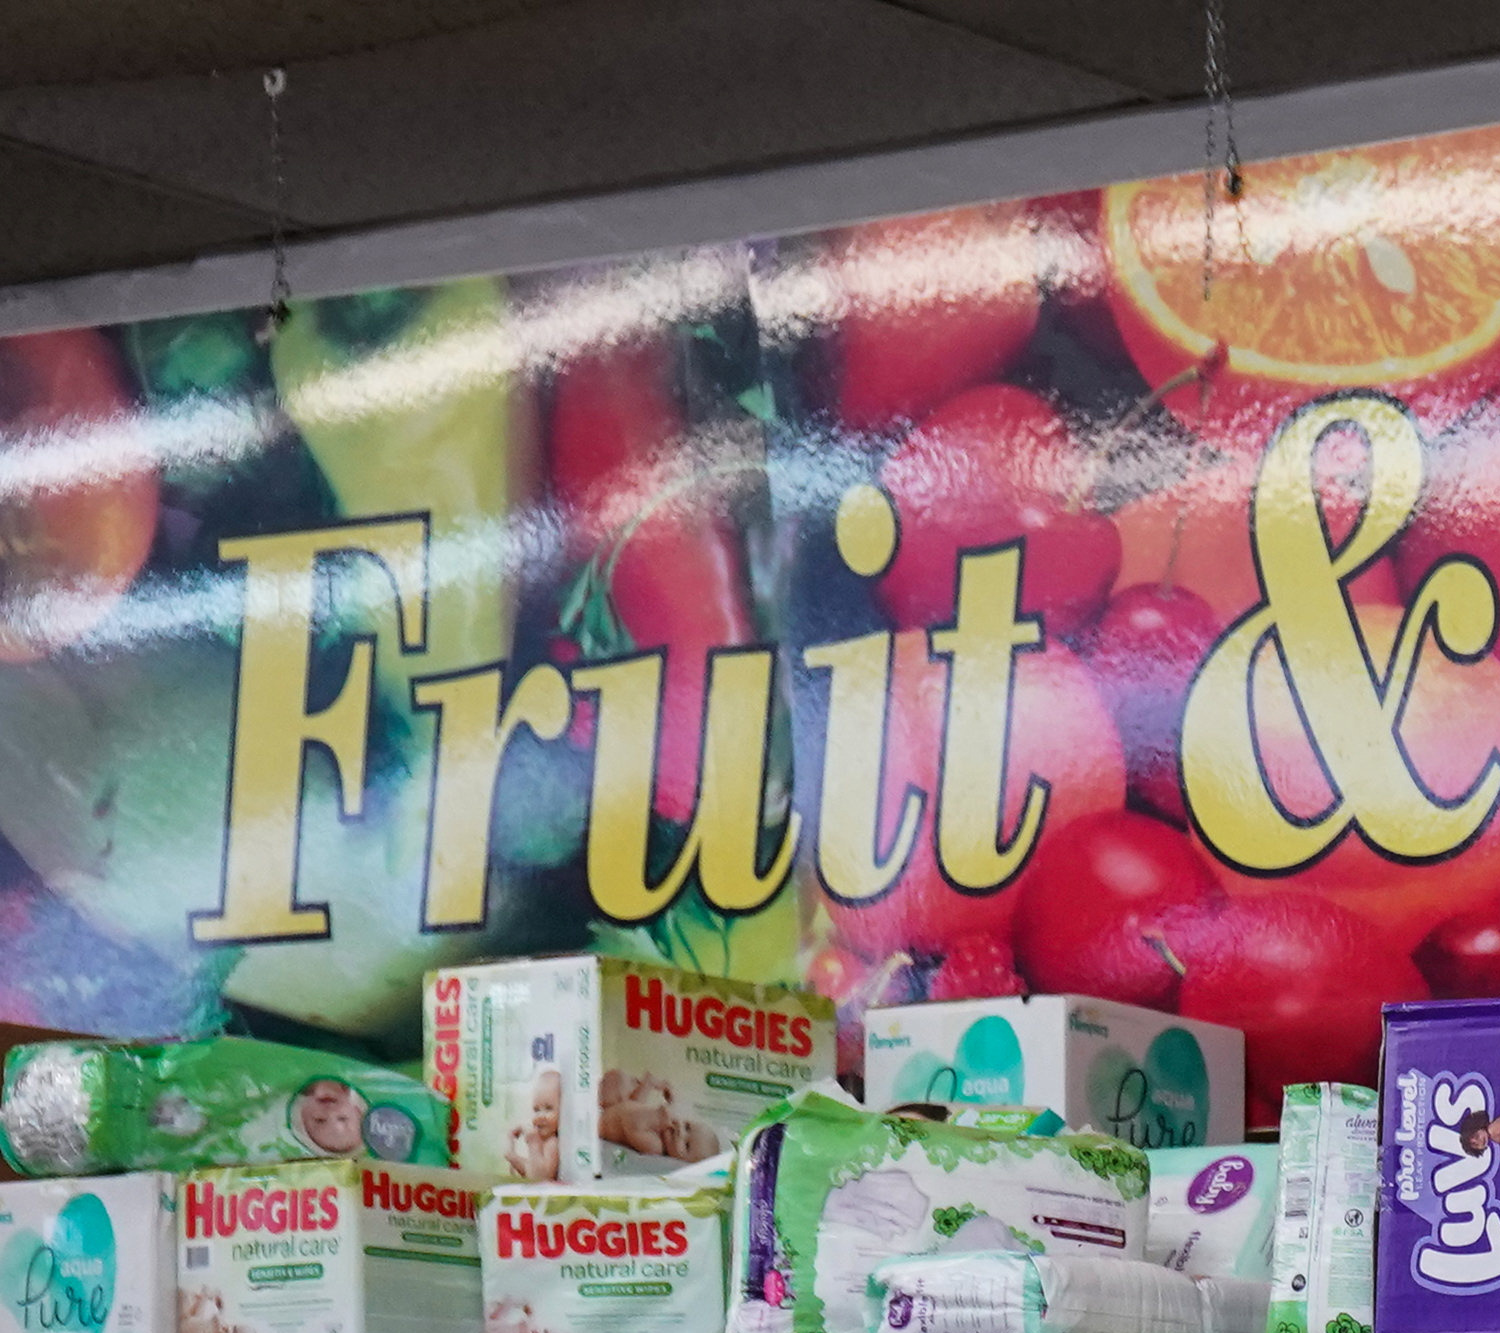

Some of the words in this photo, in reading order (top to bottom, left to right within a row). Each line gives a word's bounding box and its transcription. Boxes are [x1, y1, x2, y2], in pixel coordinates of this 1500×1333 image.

[192, 484, 1051, 945] Fruit
[463, 976, 481, 1025] care
[624, 973, 815, 1059] HUGGIES
[464, 1029, 481, 1131] natural
[685, 1046, 763, 1073] natural
[765, 1059, 814, 1083] care
[961, 1077, 1010, 1098] aqua
[1396, 1070, 1418, 1142] level
[1398, 1149, 1422, 1201] pro
[184, 1180, 339, 1240] HUGGIES
[496, 1212, 689, 1259] HUGGIES
[231, 1236, 298, 1261] natural
[300, 1238, 341, 1256] care
[560, 1260, 636, 1280] natural
[642, 1263, 689, 1278] care
[17, 1246, 108, 1331] Pure
